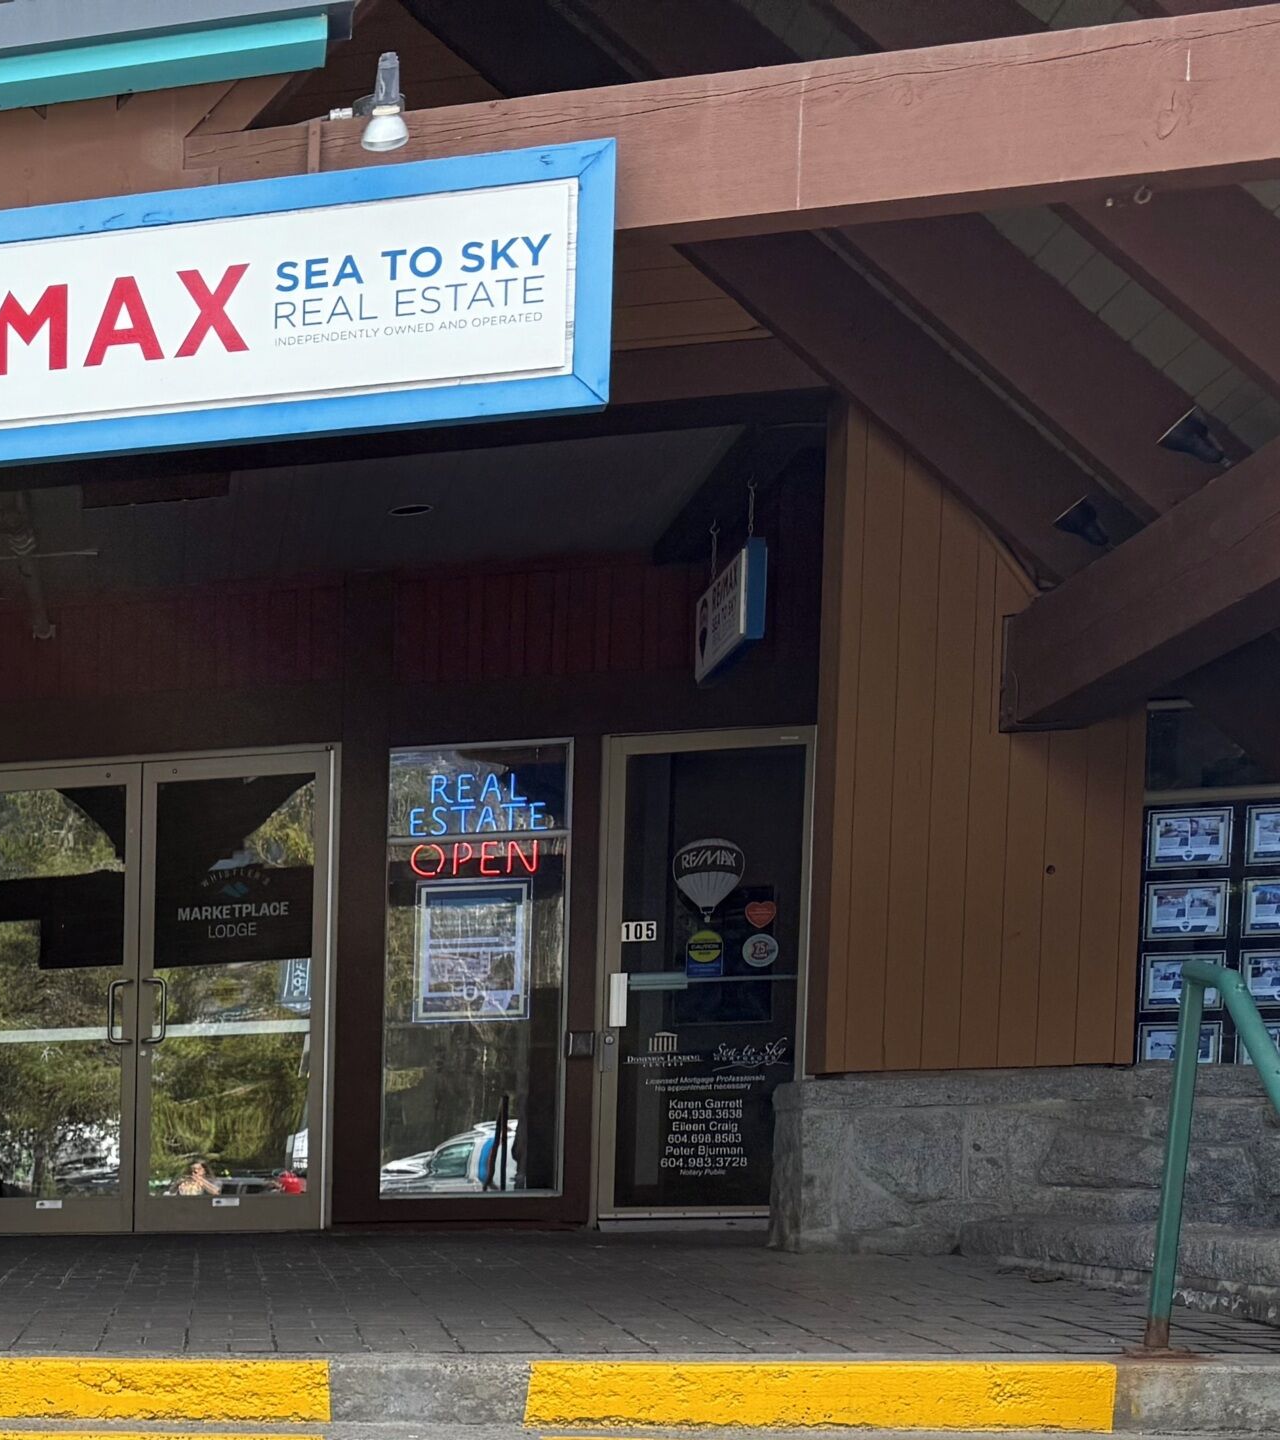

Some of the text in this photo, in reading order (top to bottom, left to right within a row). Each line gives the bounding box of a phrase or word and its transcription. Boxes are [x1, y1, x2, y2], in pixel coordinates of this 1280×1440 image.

[275, 233, 552, 292] SEA TO SKY
[274, 275, 545, 329] REAL ESTATE
[274, 311, 543, 347] INDEPENDENTLY OWNED AND OPERATED
[431, 772, 527, 804] REAL
[409, 802, 547, 836] ESTATE
[410, 840, 538, 876] OPEN
[681, 850, 736, 869] RE/MAX
[178, 901, 289, 921] MARKETPLACE
[208, 922, 257, 938] LODGE
[624, 923, 655, 940] 105
[765, 1037, 788, 1062] Sky
[645, 1074, 765, 1086] Licensed Mortgage Professionals
[667, 1084, 712, 1093] appointment
[714, 1082, 752, 1091] necessary
[669, 1100, 702, 1109] Karen
[672, 1121, 738, 1133] Eileen Craig
[665, 1145, 743, 1159] Peter Bjurman
